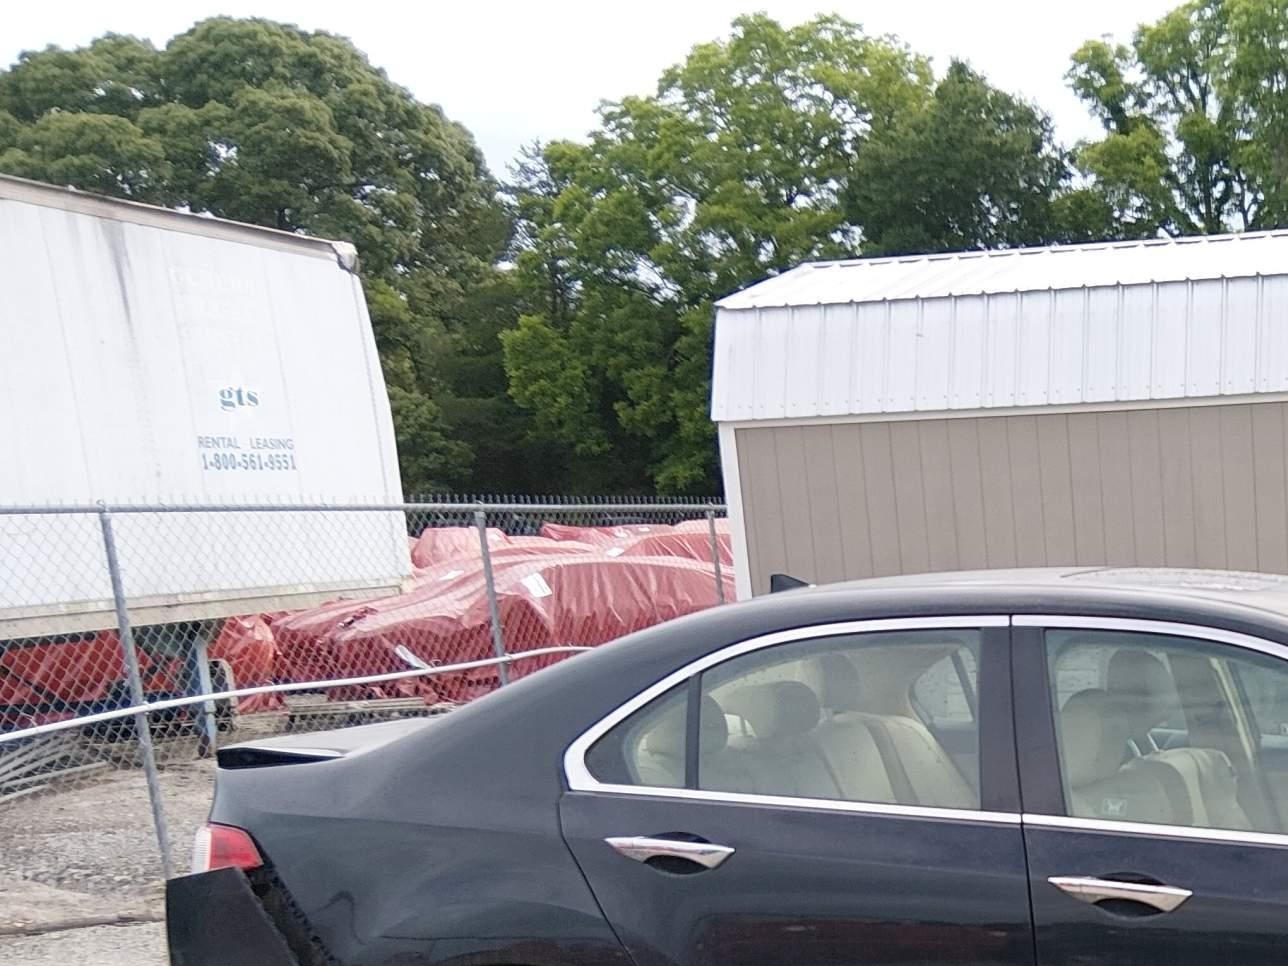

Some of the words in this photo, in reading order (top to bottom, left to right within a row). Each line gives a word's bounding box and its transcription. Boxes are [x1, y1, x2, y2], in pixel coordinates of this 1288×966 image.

[219, 387, 259, 412] gts
[198, 436, 241, 449] RENTAL
[249, 437, 295, 450] LEASING
